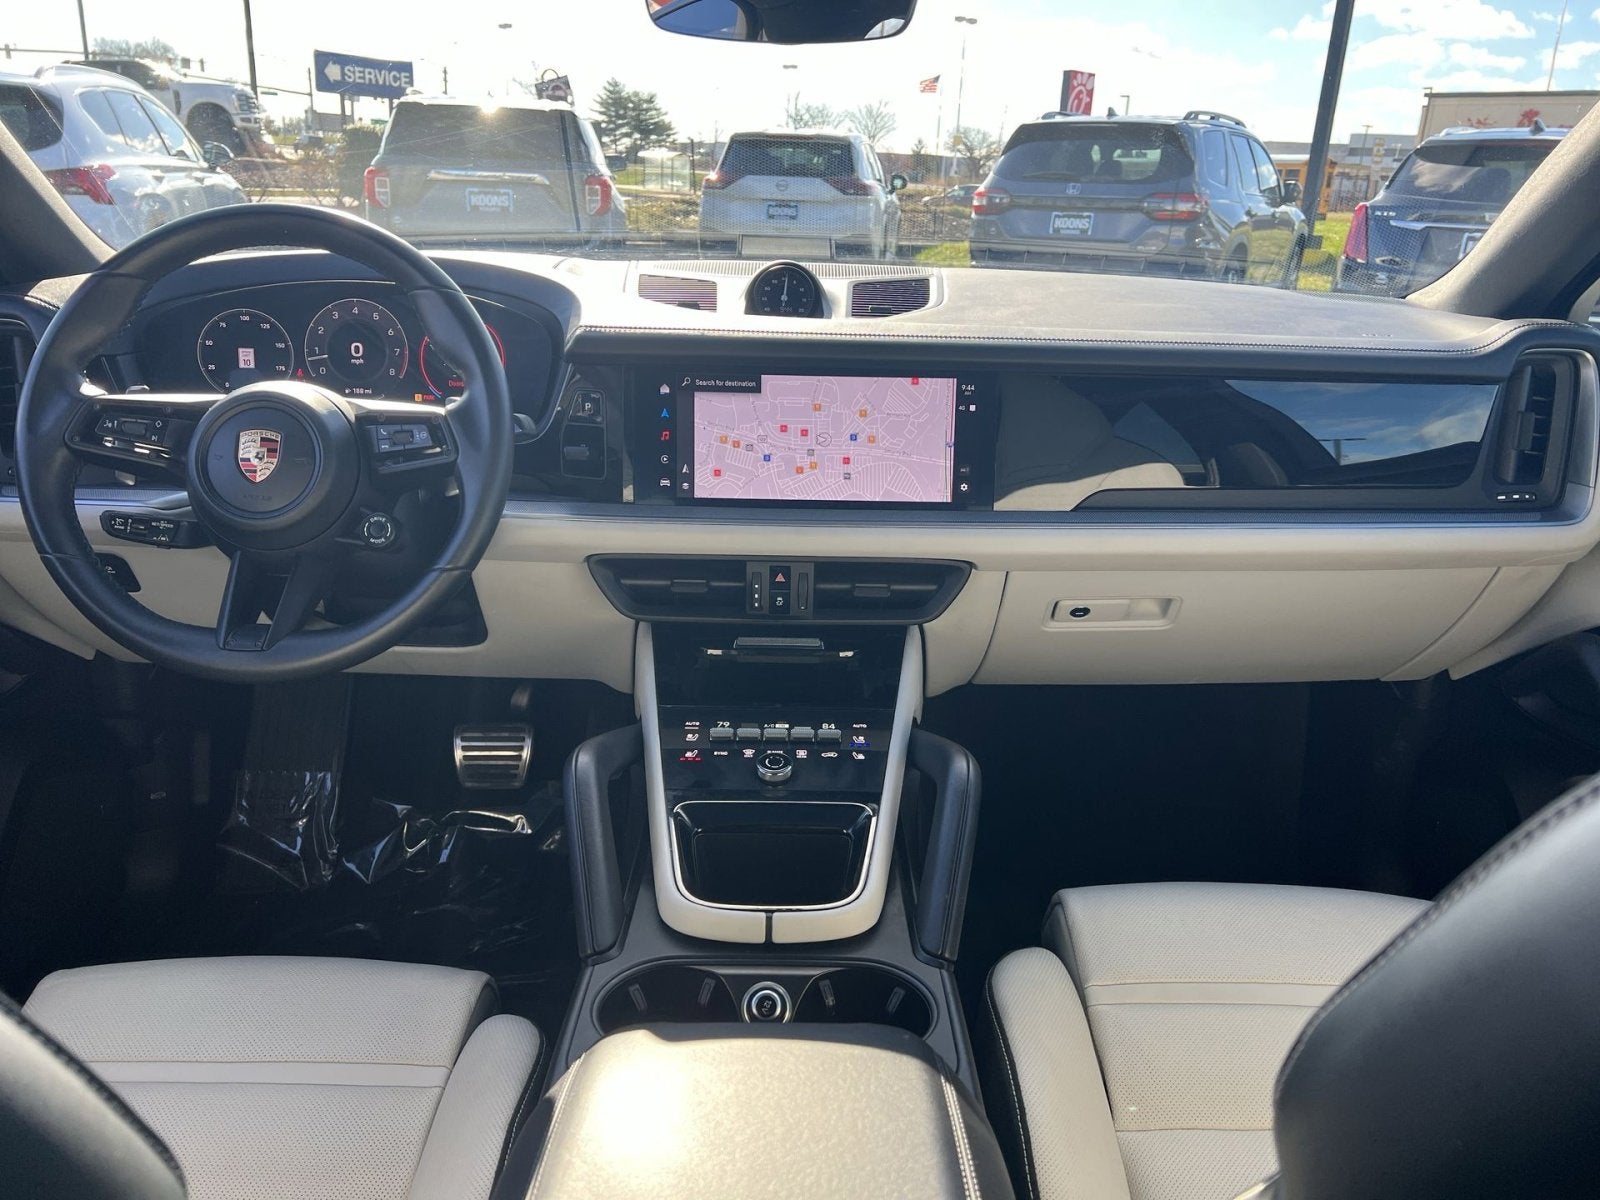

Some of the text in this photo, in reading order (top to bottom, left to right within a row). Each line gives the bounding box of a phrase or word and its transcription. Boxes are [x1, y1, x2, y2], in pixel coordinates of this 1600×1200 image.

[344, 65, 411, 87] SERVICE
[470, 194, 509, 206] KOONS
[1054, 217, 1090, 228] KOONS
[352, 306, 359, 314] 4
[332, 311, 339, 319] 3
[373, 312, 379, 320] 5
[318, 326, 324, 334] 2
[314, 346, 319, 354] 1
[350, 342, 364, 357] 0
[394, 348, 400, 356] 7
[242, 358, 251, 367] 10
[319, 367, 326, 375] 0
[389, 368, 396, 376] 8
[584, 402, 592, 410] P
[240, 430, 280, 439] PORSCHE
